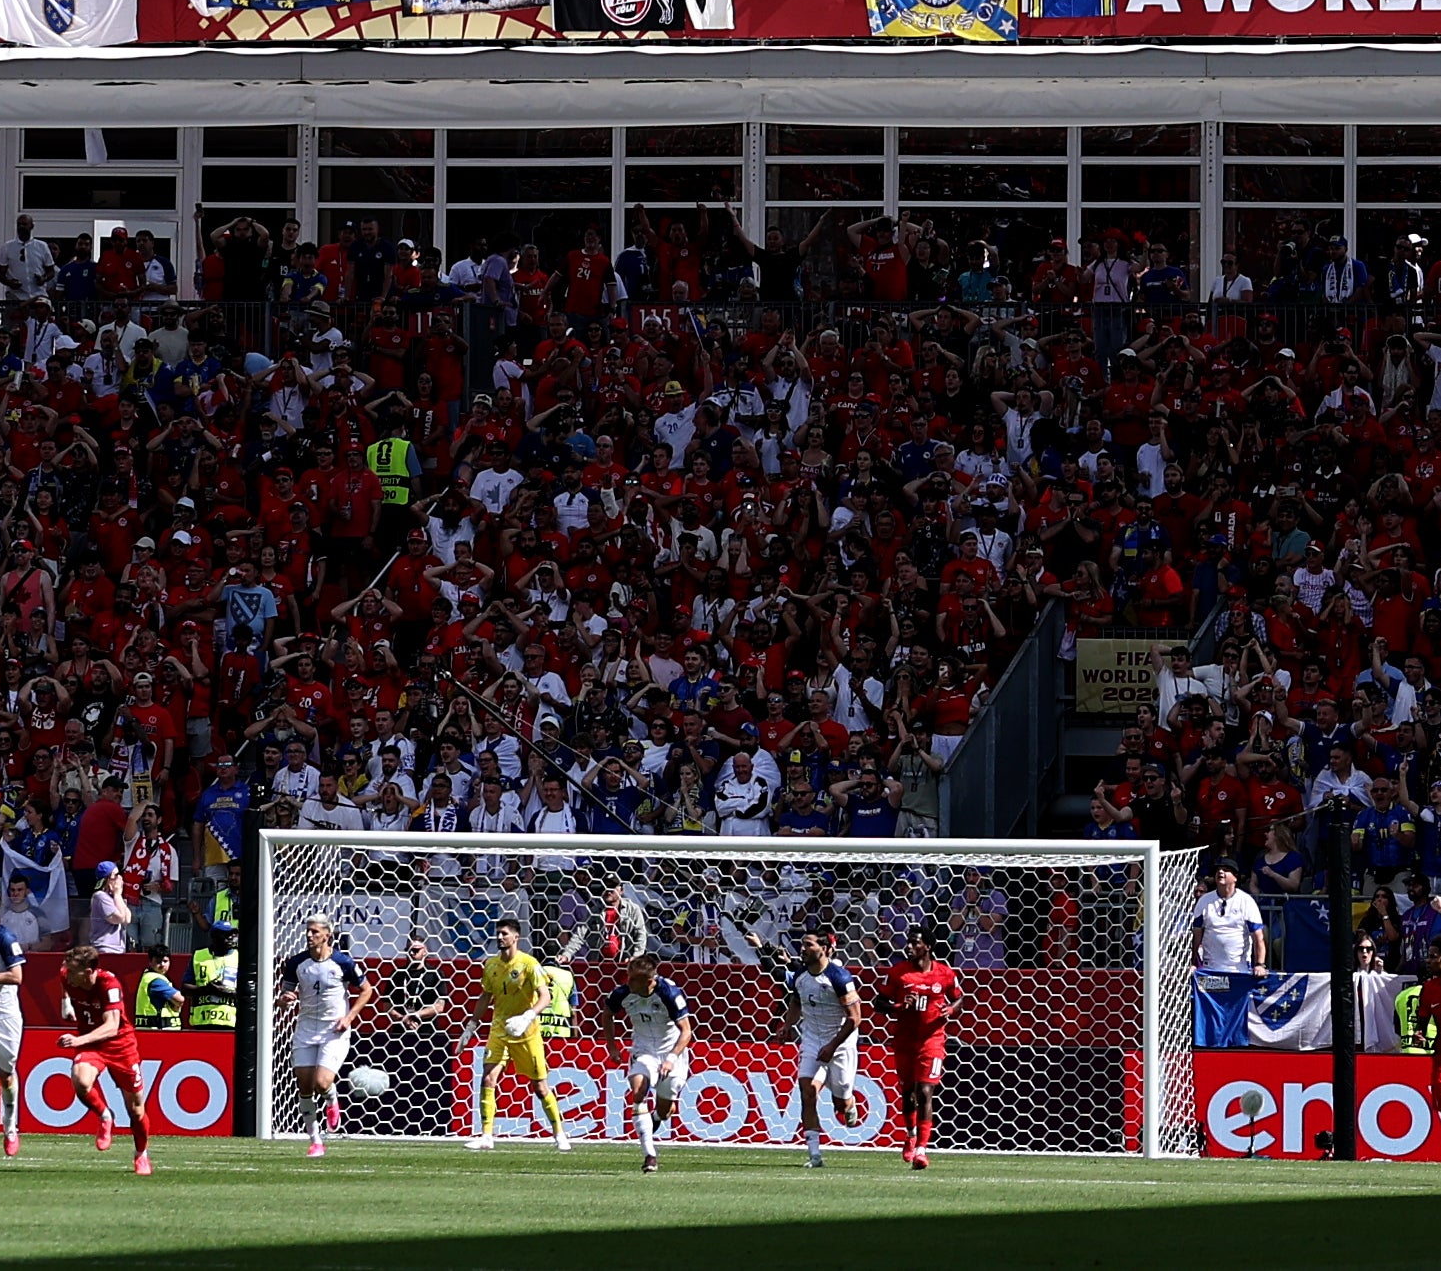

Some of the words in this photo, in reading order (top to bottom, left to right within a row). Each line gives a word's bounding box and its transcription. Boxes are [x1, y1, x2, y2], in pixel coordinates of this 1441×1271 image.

[577, 268, 590, 279] 24
[416, 312, 434, 334] 11
[1117, 652, 1152, 667] FIFA
[1082, 669, 1145, 685] WORLD
[300, 696, 311, 708] 20
[313, 980, 321, 995] 4
[83, 1010, 93, 1026] 2
[476, 1046, 886, 1143] Leovo
